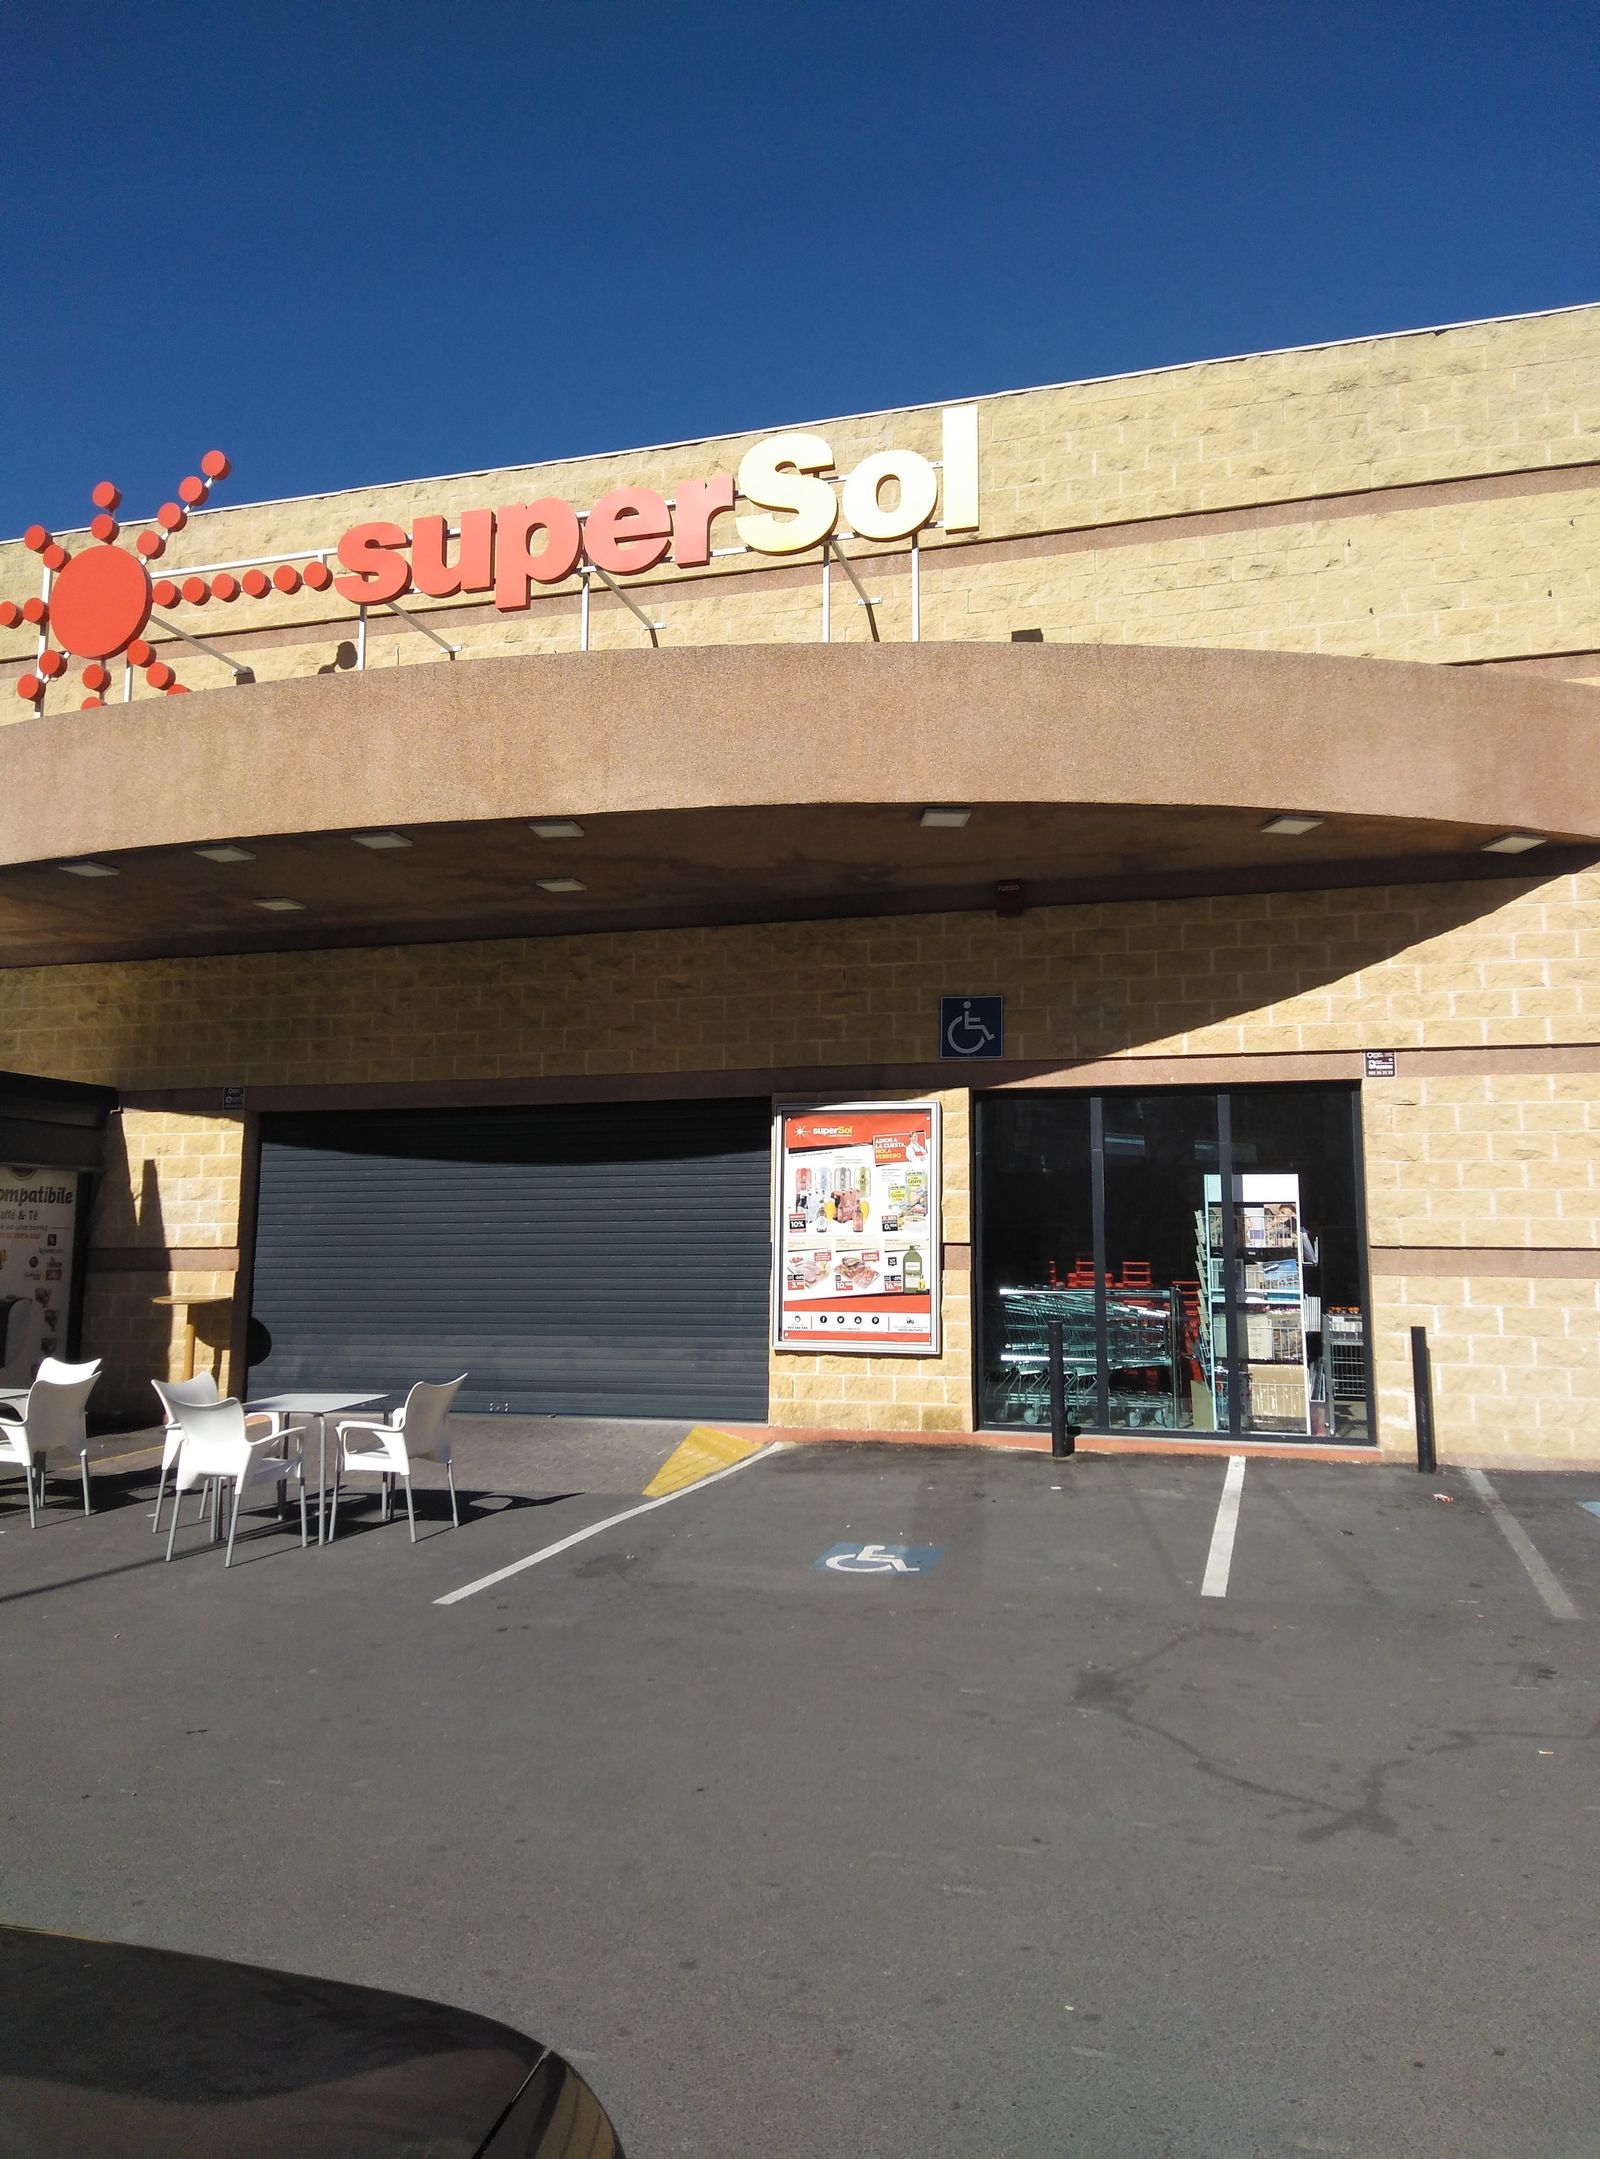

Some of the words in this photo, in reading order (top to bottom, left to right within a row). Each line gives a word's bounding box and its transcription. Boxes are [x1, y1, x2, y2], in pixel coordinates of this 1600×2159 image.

[336, 402, 980, 612] superSol
[812, 1125, 853, 1136] superSol
[875, 1152, 902, 1160] FEBRERO
[18, 1209, 26, 1220] &
[790, 1221, 805, 1229] 10%
